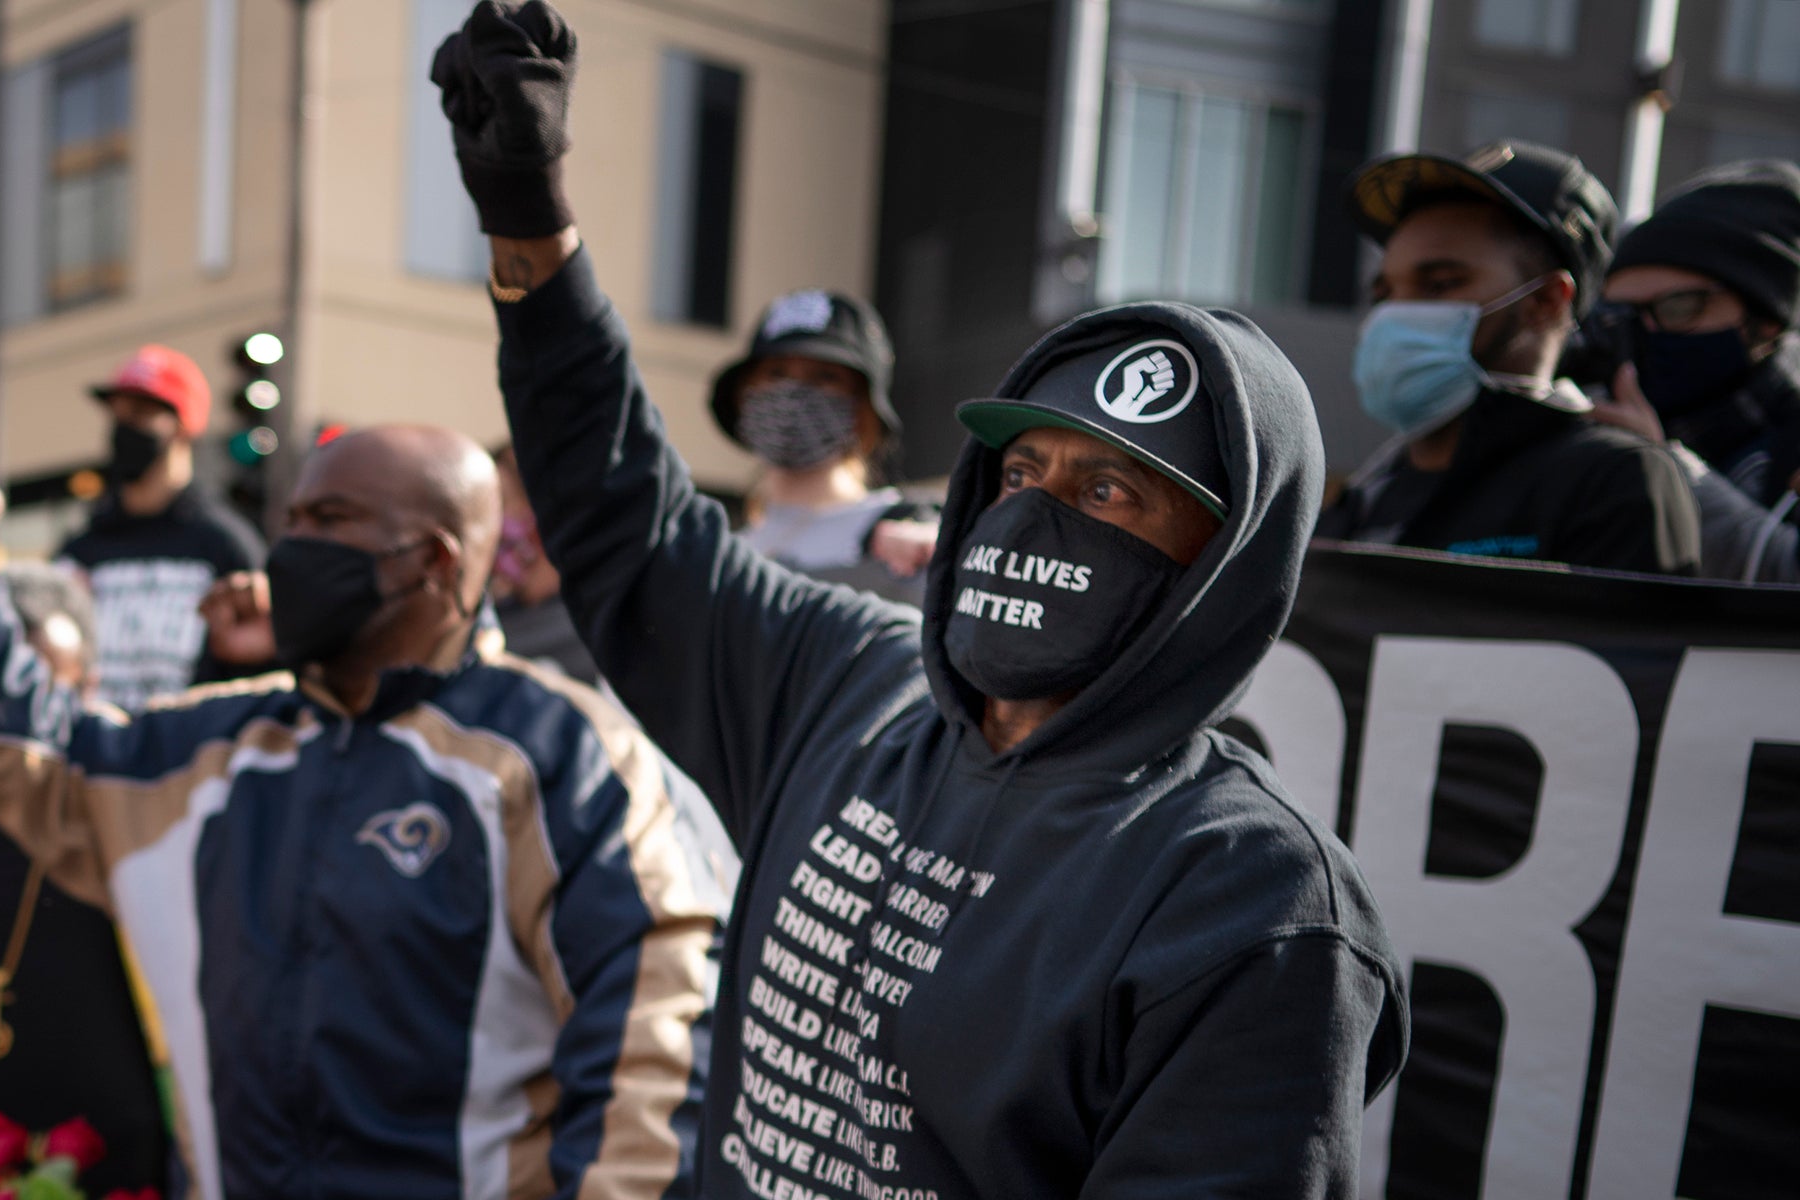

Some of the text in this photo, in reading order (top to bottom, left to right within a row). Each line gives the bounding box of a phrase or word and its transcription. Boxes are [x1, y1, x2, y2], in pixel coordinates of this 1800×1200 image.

[1003, 551, 1093, 592] LIVES
[809, 824, 882, 883] LEAD
[790, 860, 873, 926] FIGHT
[773, 897, 855, 966] THINK
[760, 937, 840, 1007] WRITE
[748, 974, 822, 1040] BUILD
[822, 1023, 861, 1063] LIKE
[740, 1014, 819, 1086] SPEAK
[816, 1065, 856, 1104] LIKE
[741, 1057, 838, 1138] DUCATE
[834, 1117, 864, 1155] LIKE
[733, 1093, 815, 1174] BLIEVE
[813, 1152, 856, 1191] LIKE
